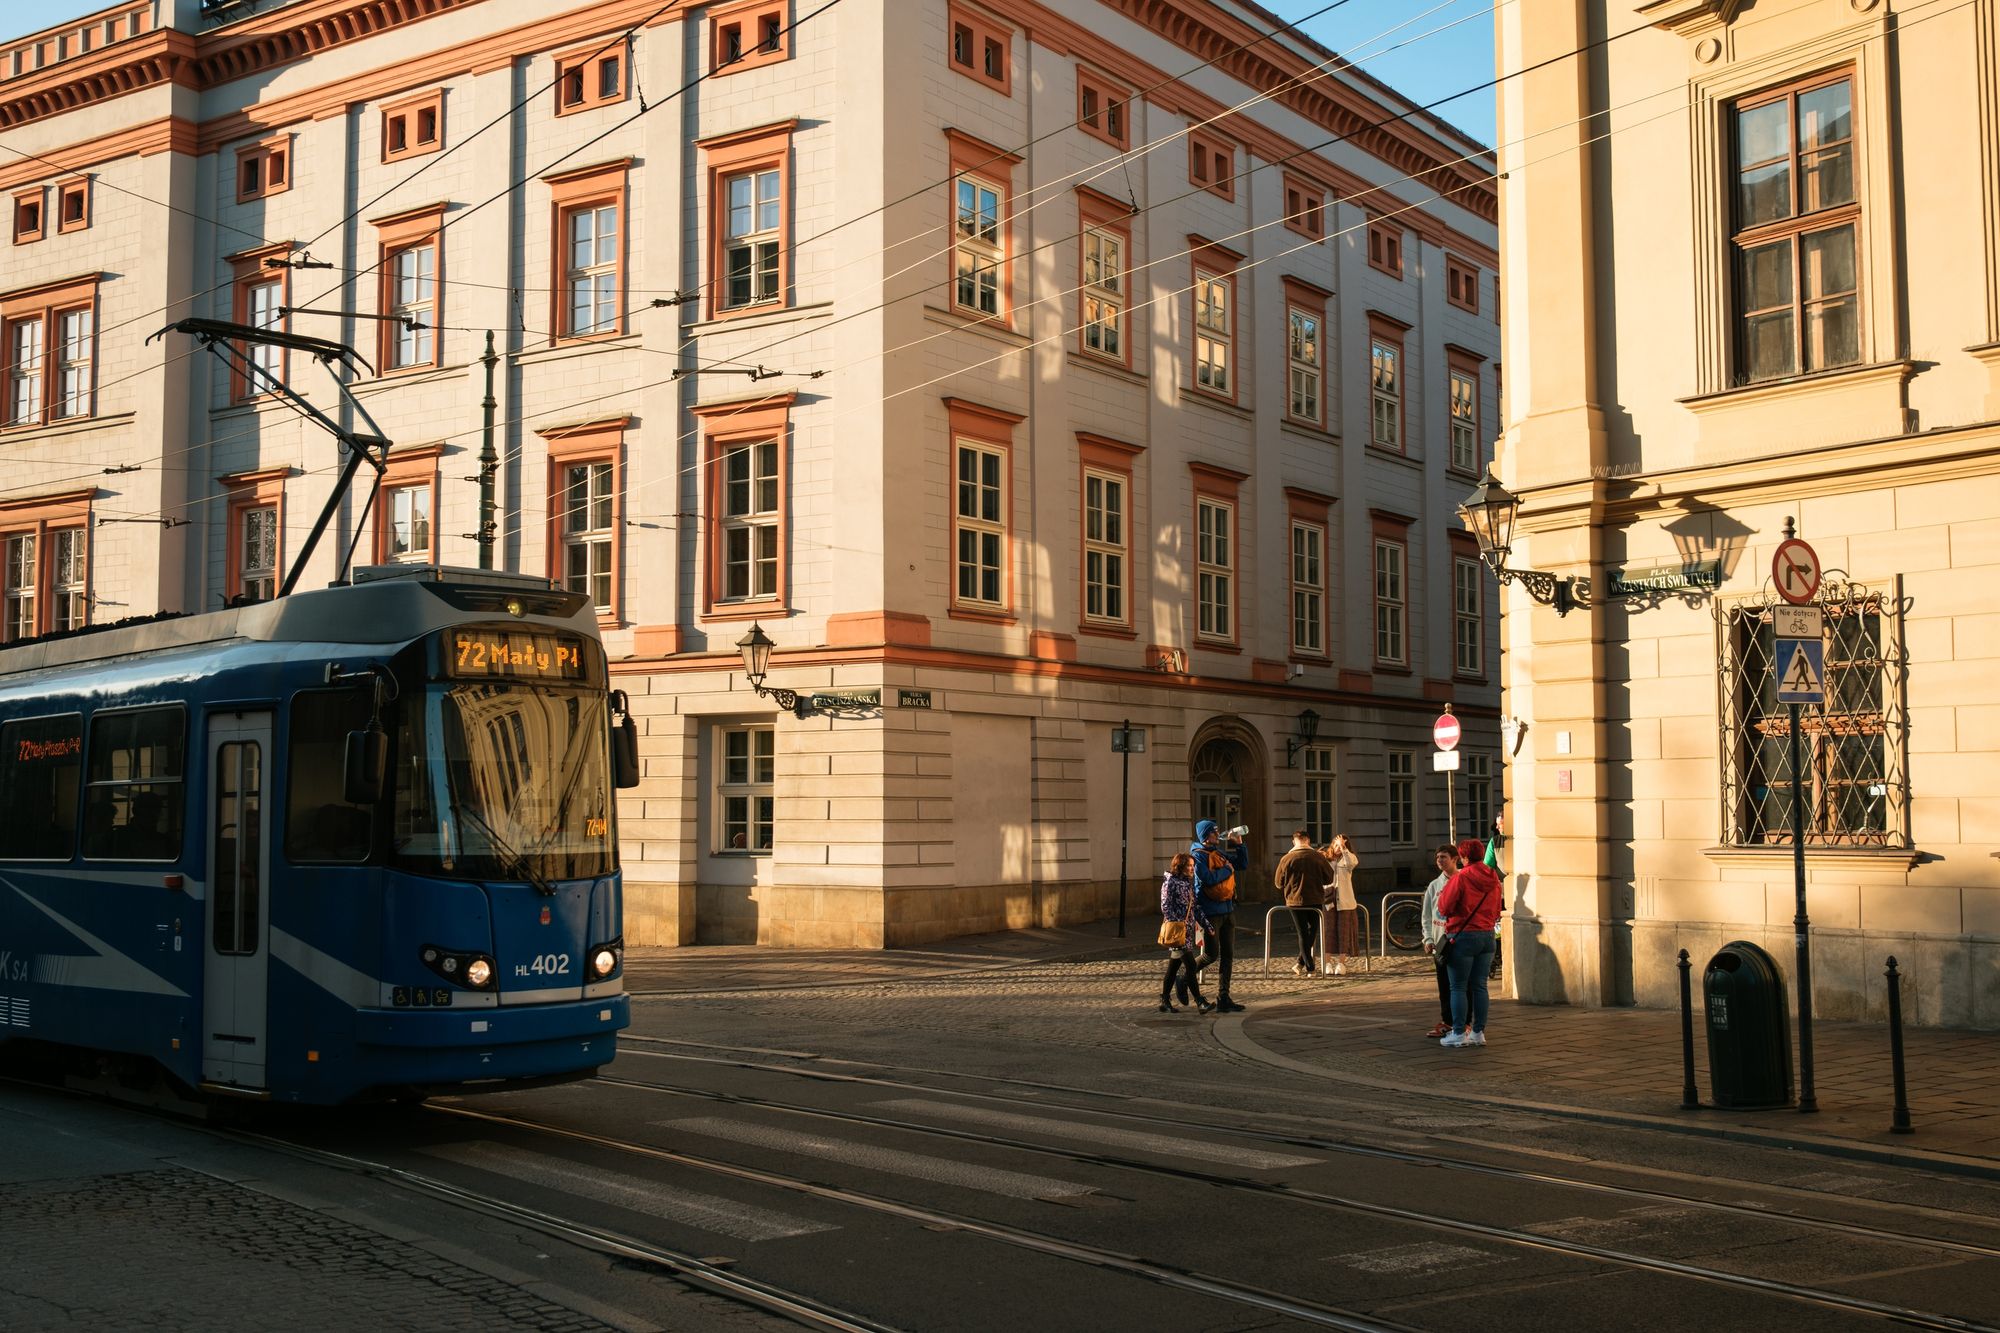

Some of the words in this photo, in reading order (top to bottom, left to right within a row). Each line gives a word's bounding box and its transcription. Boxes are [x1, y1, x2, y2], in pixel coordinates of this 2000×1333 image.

[1650, 567, 1672, 576] PLAC
[1610, 576, 1667, 594] WSZYSTKICH
[1780, 608, 1790, 617] Nie
[1793, 608, 1817, 619] dotyczy
[457, 641, 486, 668] 72
[491, 642, 549, 671] Mały
[902, 696, 930, 707] BRACKA
[19, 740, 31, 761] 72
[12, 959, 28, 982] SA
[515, 964, 530, 977] HL
[530, 953, 570, 975] 402
